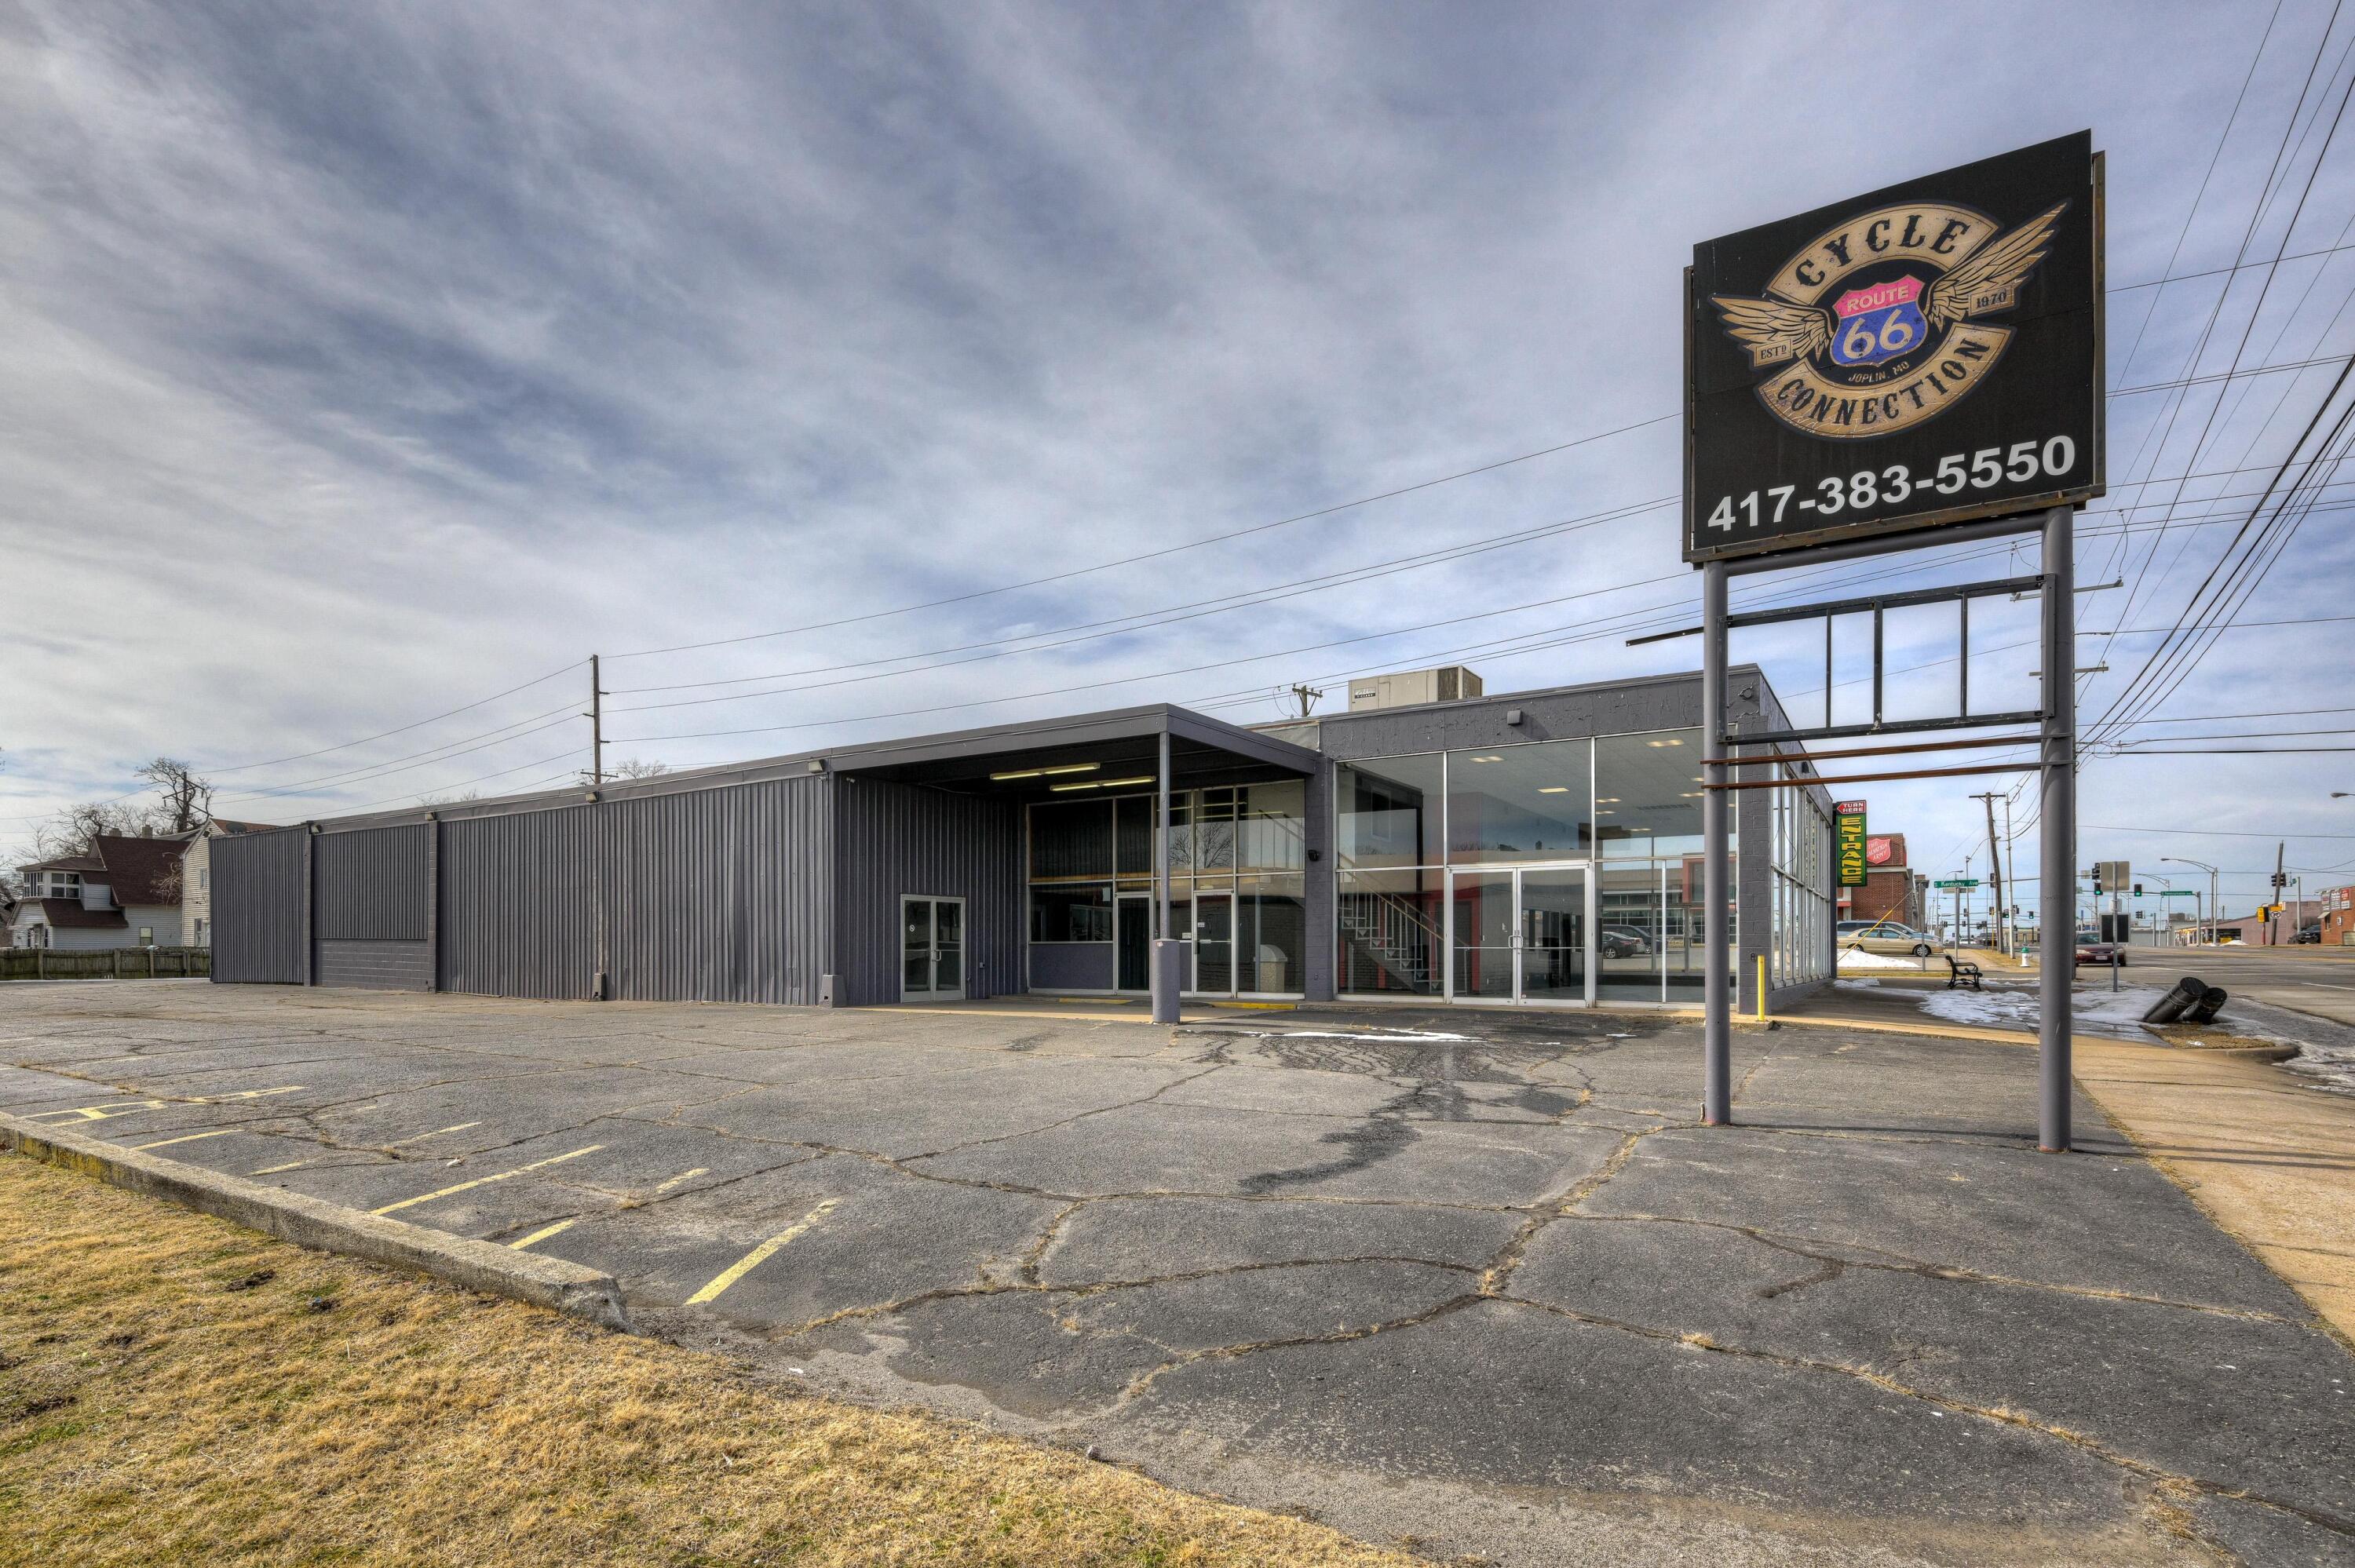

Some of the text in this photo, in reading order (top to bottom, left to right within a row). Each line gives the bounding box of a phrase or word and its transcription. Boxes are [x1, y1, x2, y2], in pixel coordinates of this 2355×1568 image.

[1795, 214, 1971, 286] CYCLE
[1847, 285, 1910, 312] ROUTE
[1976, 290, 2007, 308] 1970
[1843, 308, 1913, 359] 66
[1777, 337, 1991, 425] CONNECTION
[1707, 435, 2076, 531] 417-383-5550
[1841, 817, 1862, 884] ENTRANCE
[1867, 841, 1888, 856] ALVATION
